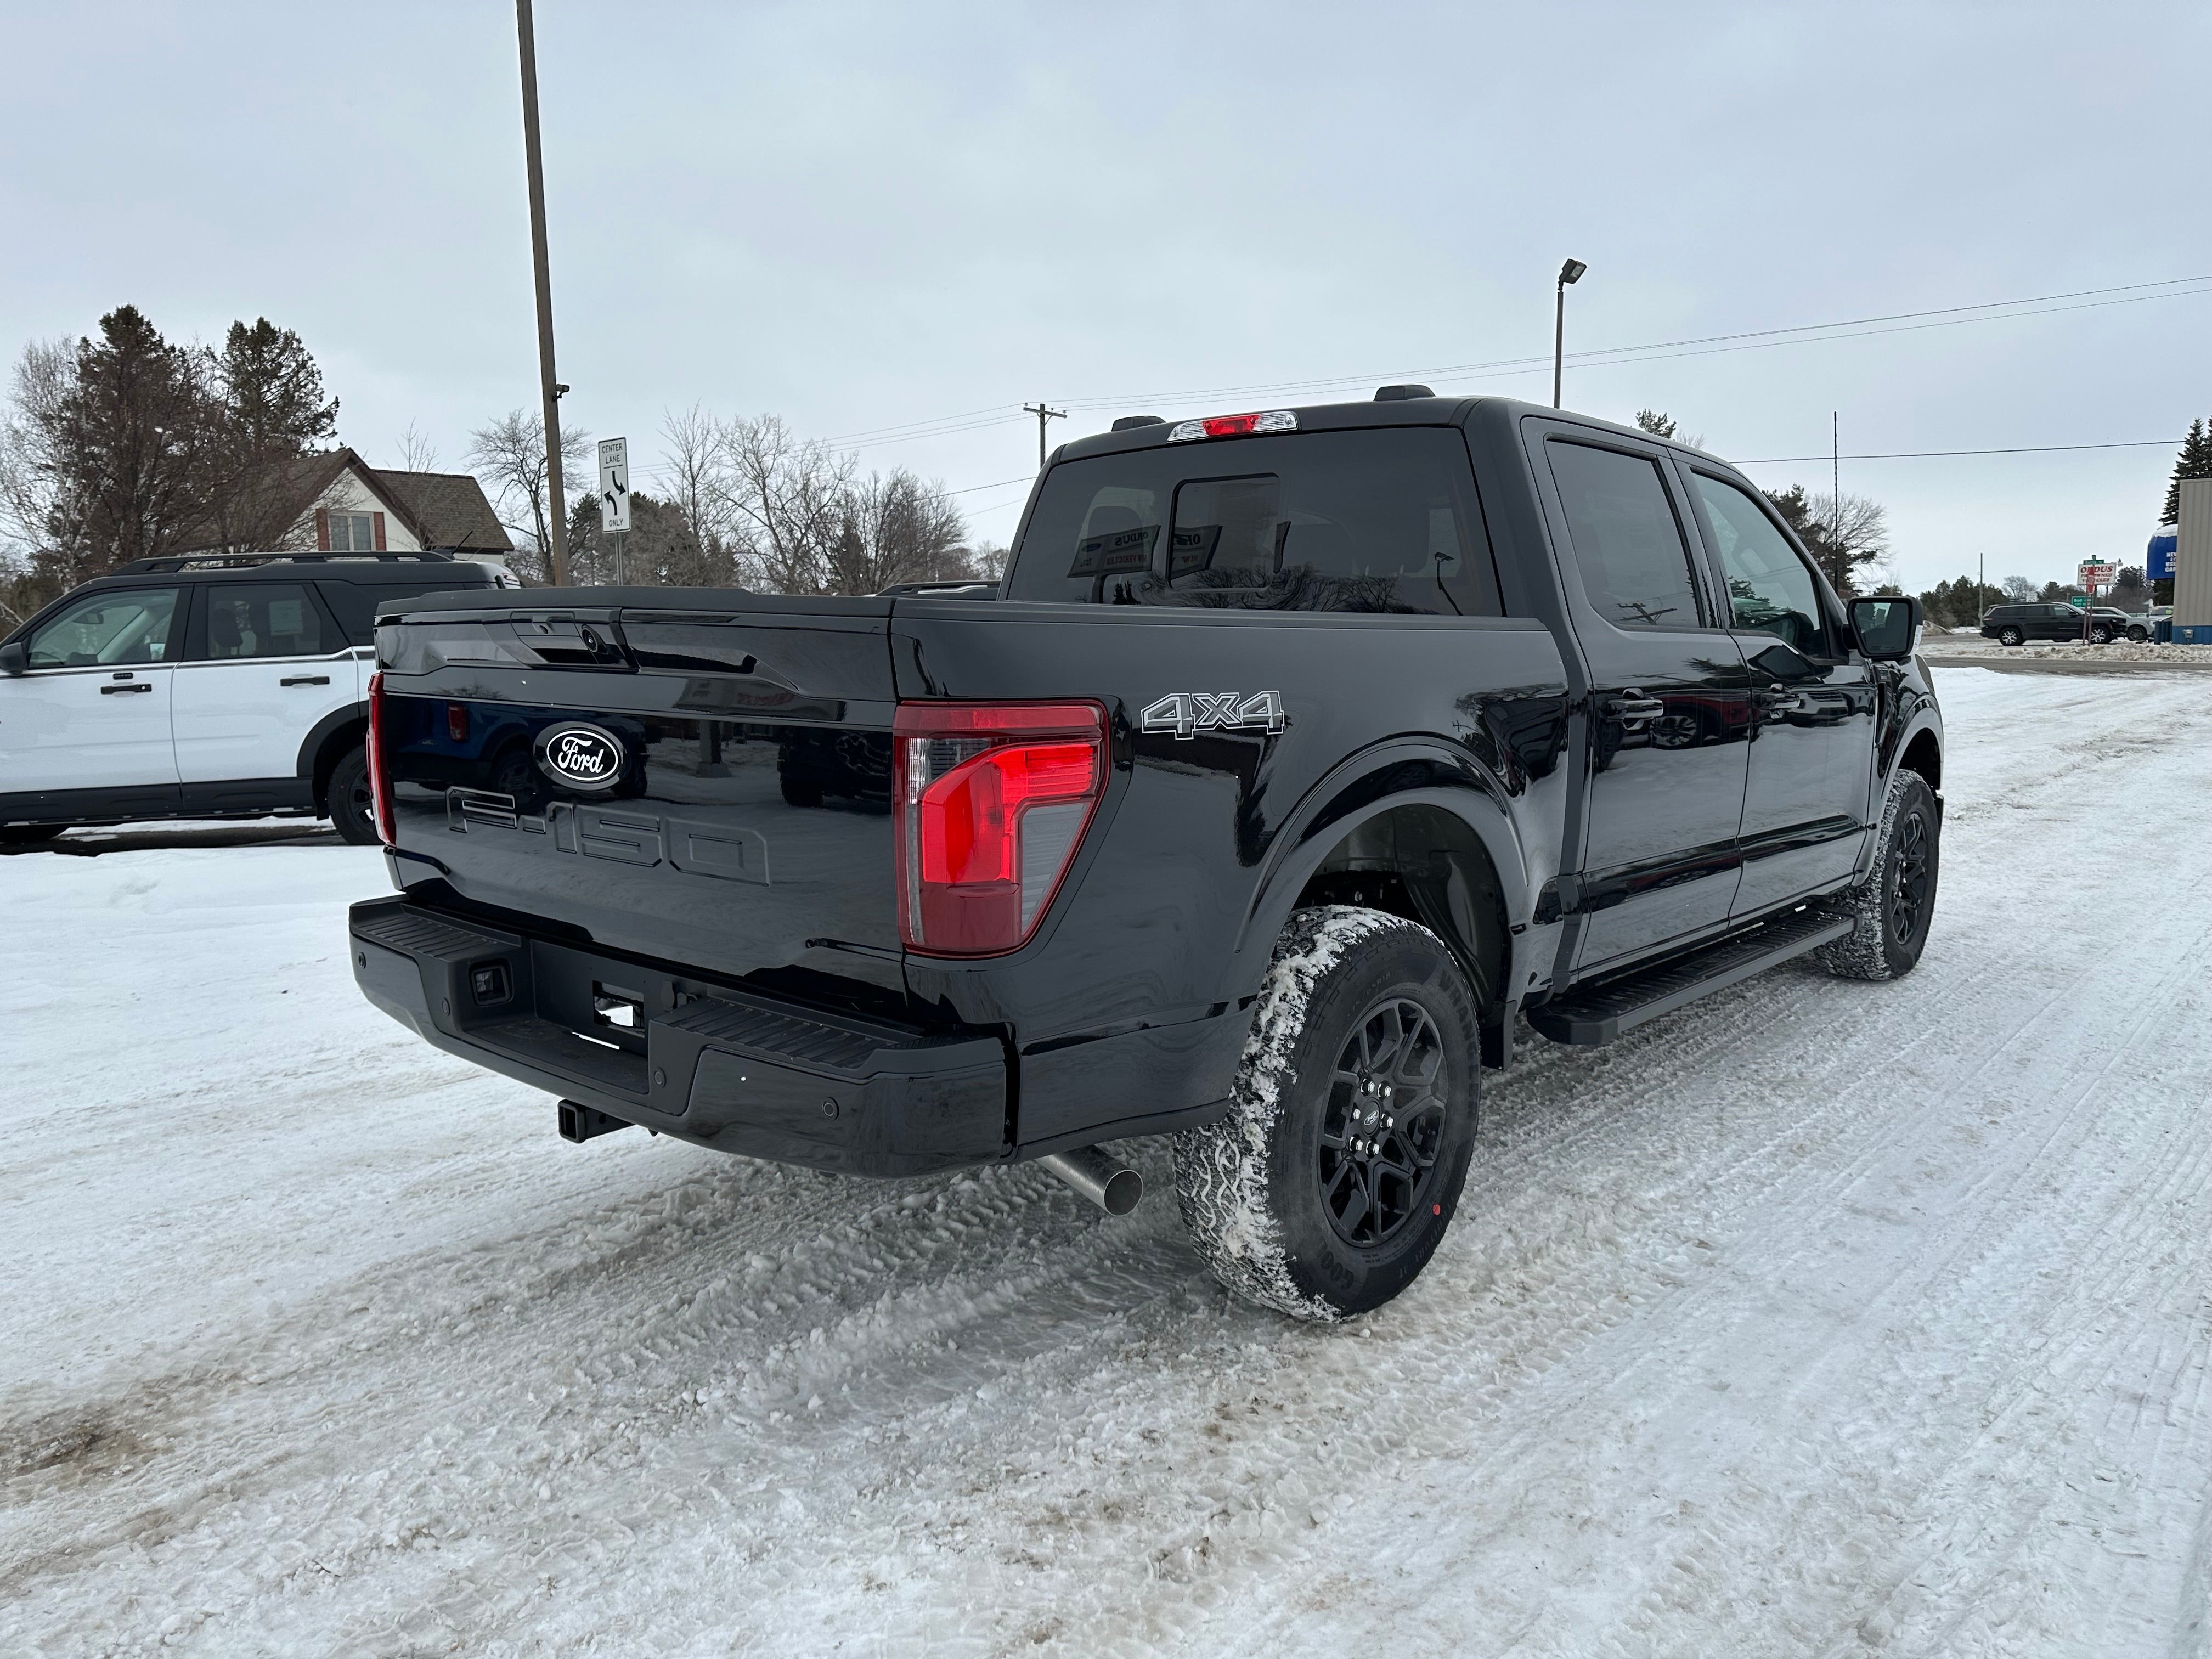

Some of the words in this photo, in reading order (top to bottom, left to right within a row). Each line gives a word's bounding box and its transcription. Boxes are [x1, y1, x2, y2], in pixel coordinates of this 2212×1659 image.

[602, 443, 623, 453] CENTER
[606, 455, 620, 464] LANE
[609, 518, 623, 527] ONLY
[558, 736, 604, 774] Ford
[445, 786, 770, 887] F-150
